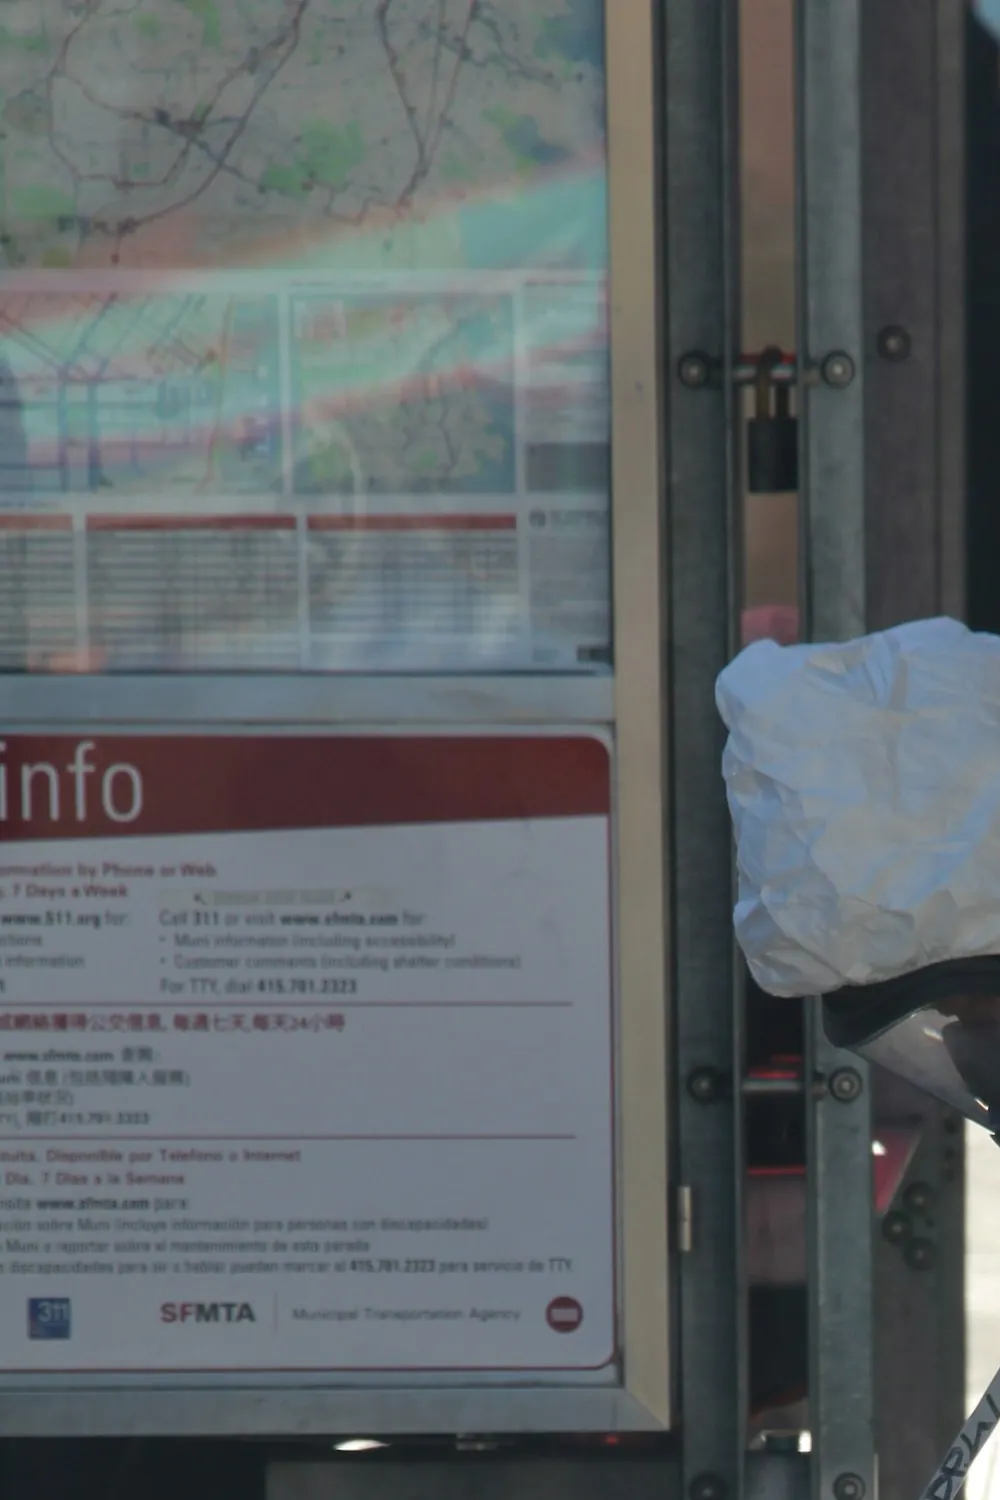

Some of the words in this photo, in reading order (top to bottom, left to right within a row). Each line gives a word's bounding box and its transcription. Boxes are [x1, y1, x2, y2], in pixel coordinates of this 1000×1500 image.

[0, 740, 144, 822] info
[77, 862, 98, 881] by
[102, 861, 156, 878] Phone
[159, 865, 177, 878] or
[179, 862, 218, 877] Web
[26, 883, 68, 900] Days
[82, 883, 128, 898] Week
[191, 909, 220, 926] 311
[223, 912, 240, 927] or
[213, 934, 289, 948] information
[4, 954, 86, 968] information
[159, 977, 186, 994] For
[45, 1148, 125, 1164] Disponible
[127, 1151, 155, 1165] por
[242, 1149, 302, 1162] Internet
[125, 1171, 186, 1186] Semana
[37, 1301, 69, 1322] 311
[159, 1302, 257, 1323] SFMTA
[290, 1308, 360, 1322] Municipal
[362, 1308, 465, 1321] Transportation
[468, 1308, 522, 1322] Agency
